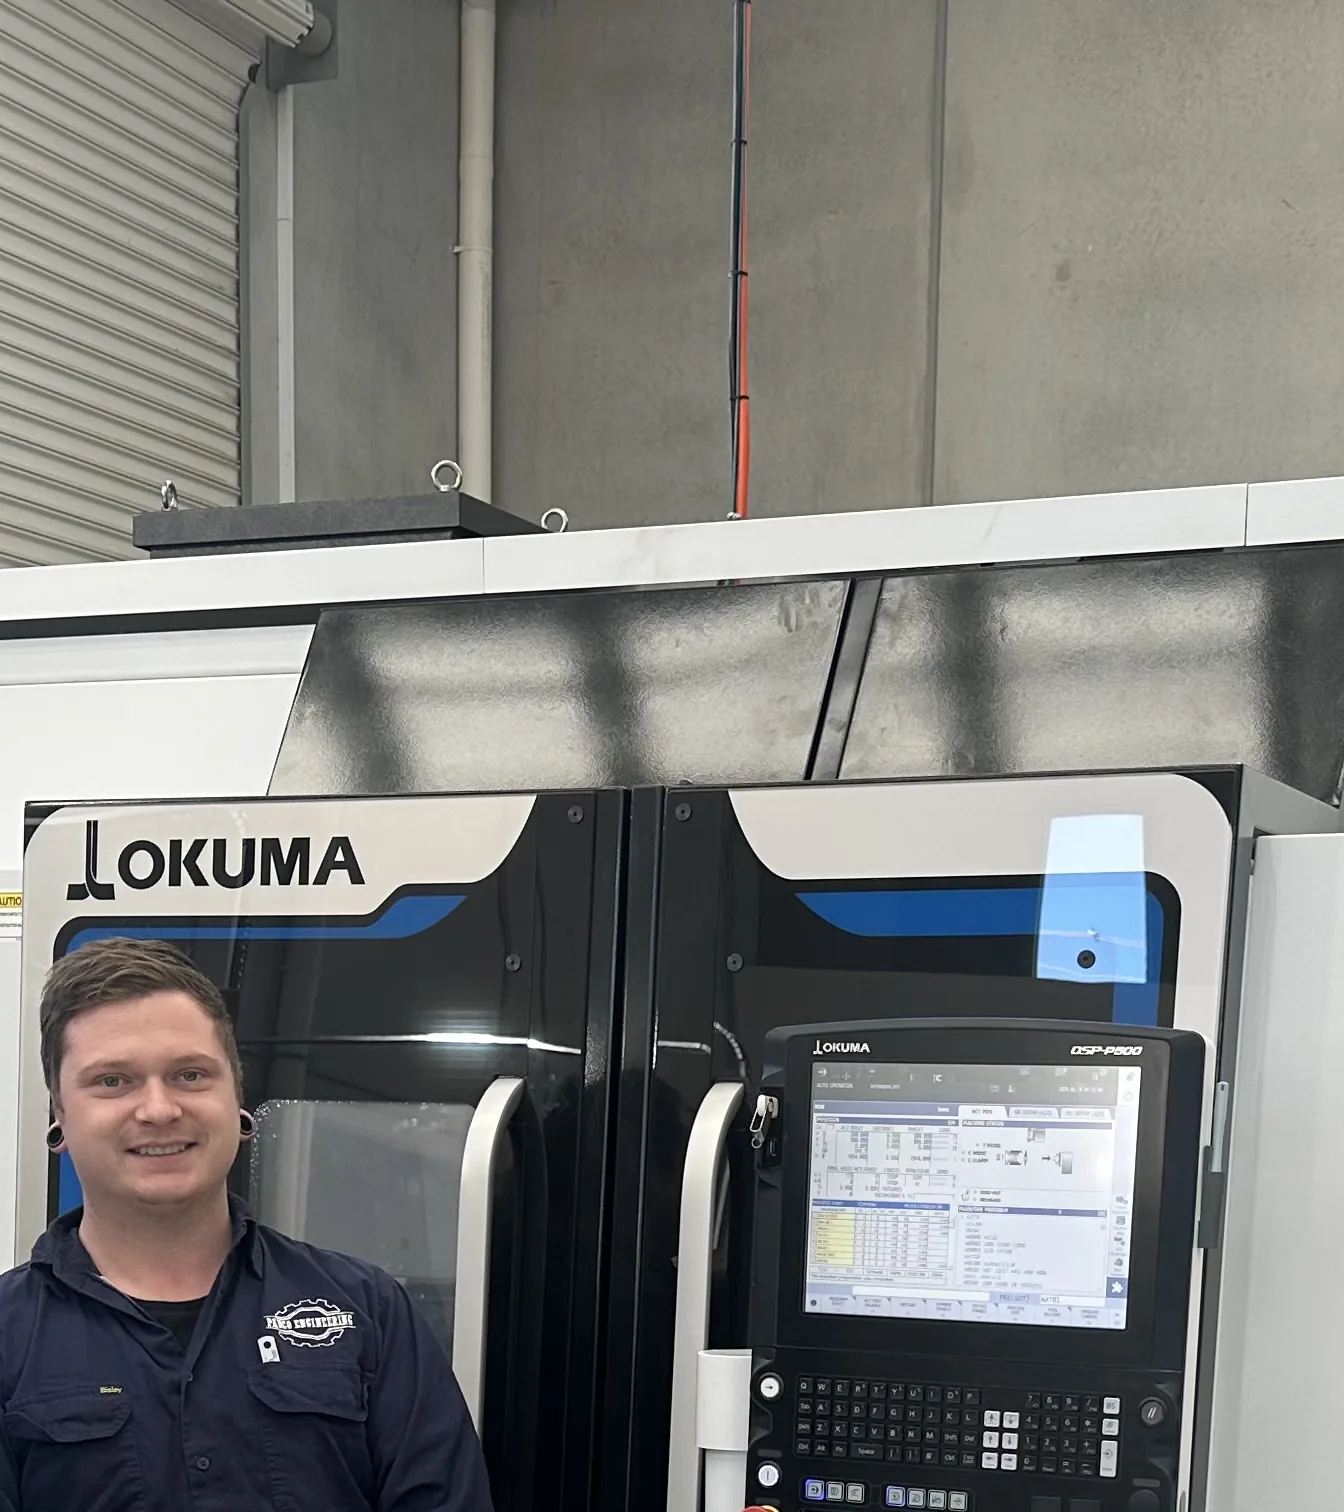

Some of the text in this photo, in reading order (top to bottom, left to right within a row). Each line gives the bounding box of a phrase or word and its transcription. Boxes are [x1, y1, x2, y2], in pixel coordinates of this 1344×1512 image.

[118, 836, 365, 889] OKUMA
[822, 1042, 871, 1053] OKUMA
[1070, 1044, 1143, 1056] OSP-P500
[293, 1314, 354, 1329] ENGINEERING
[1106, 1402, 1115, 1410] BS
